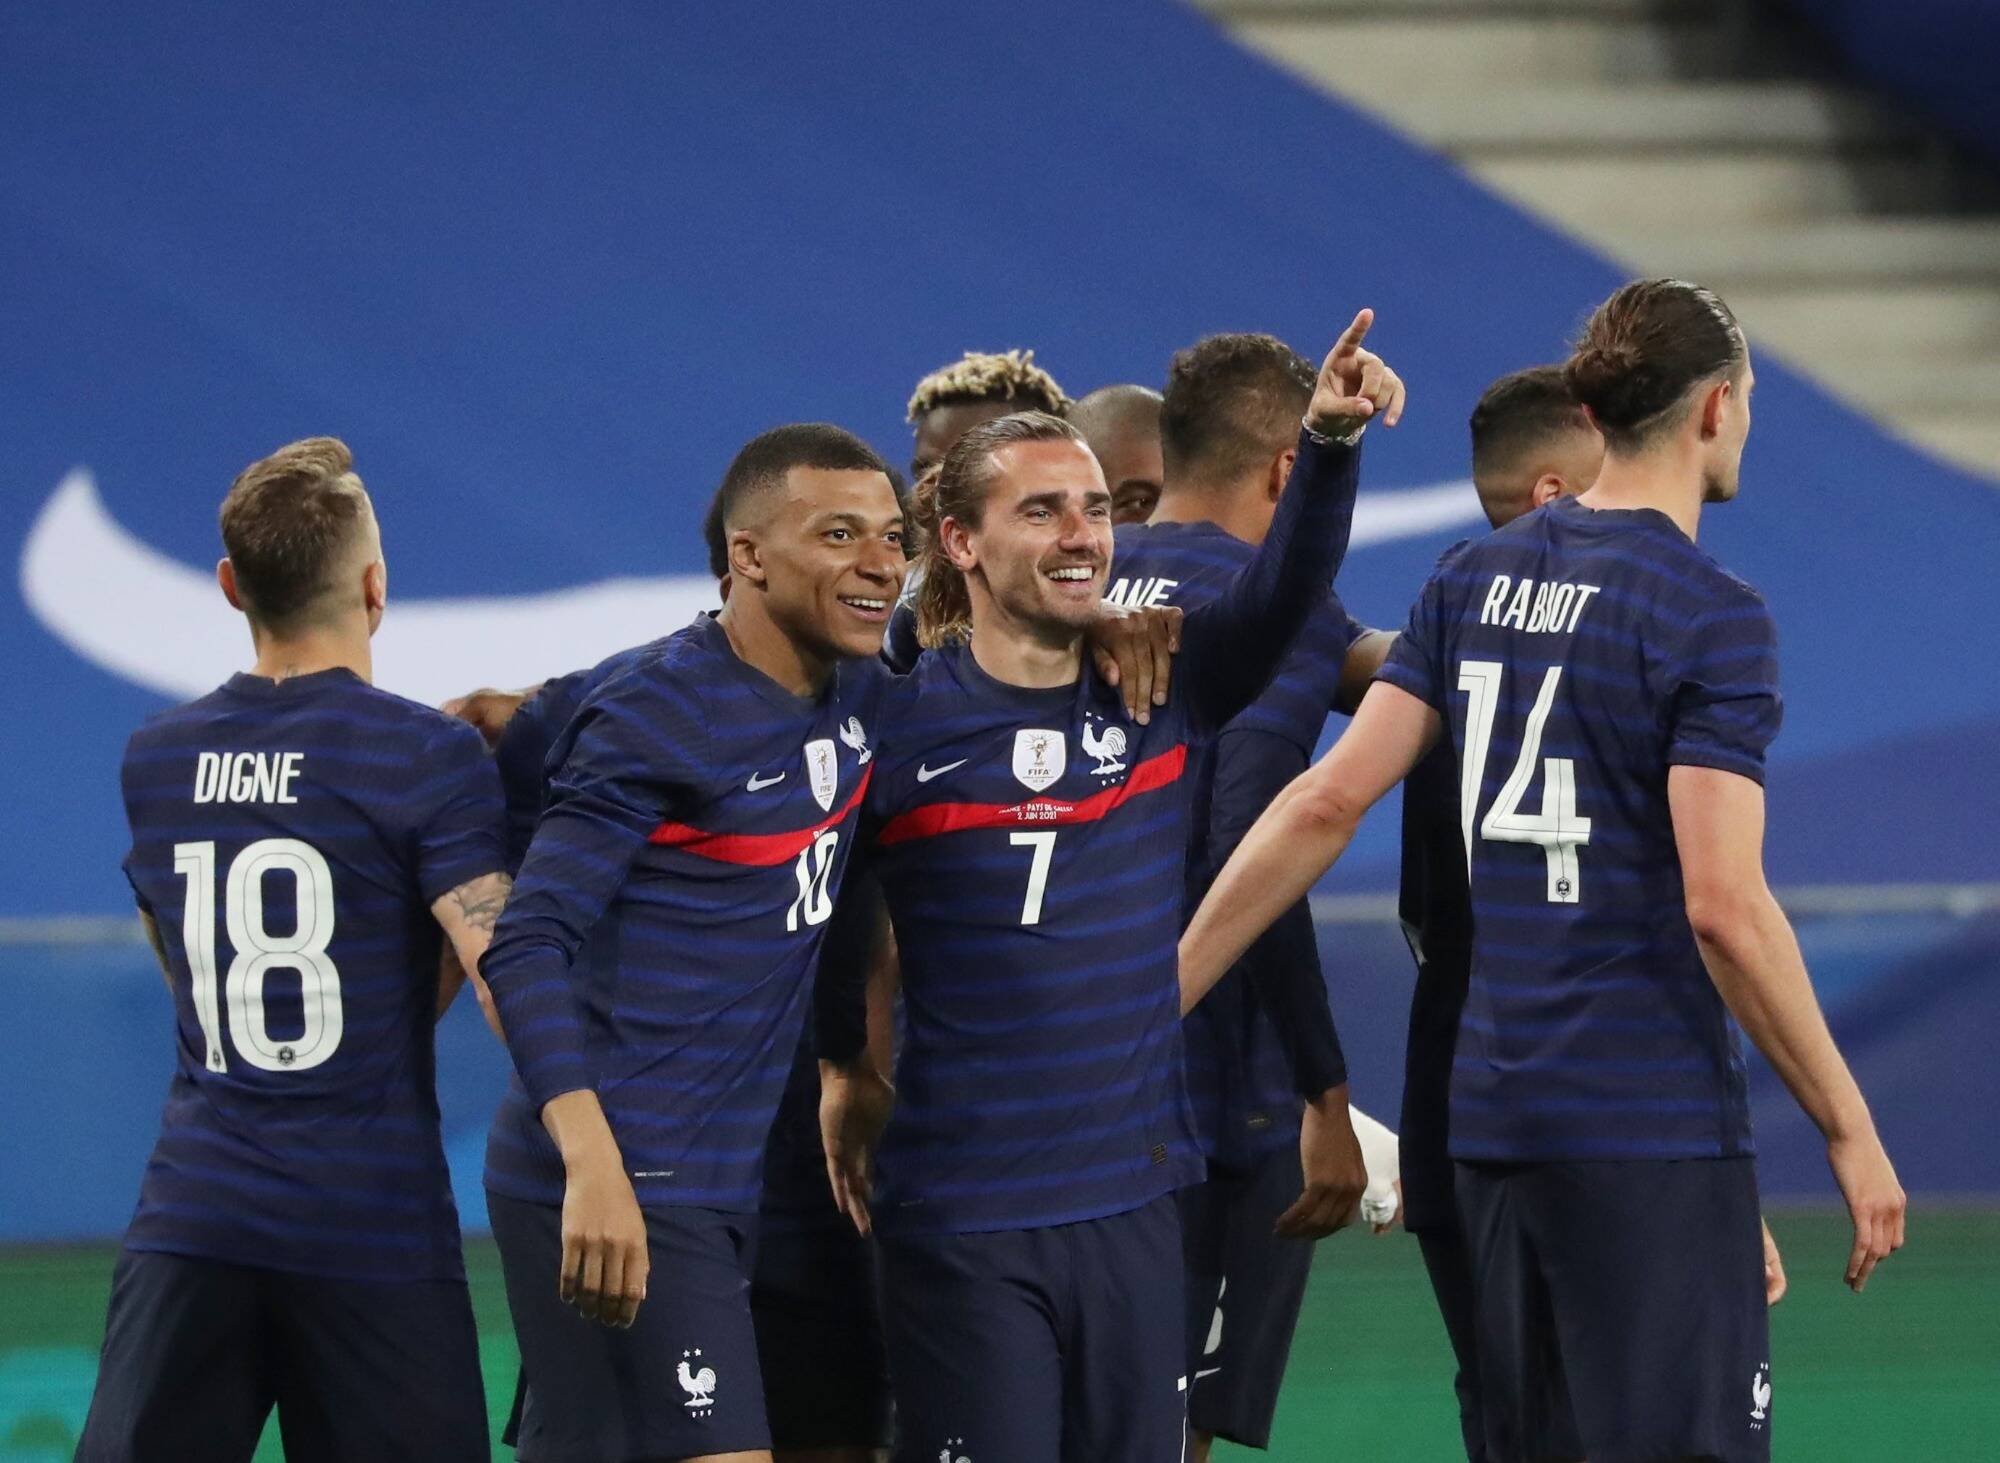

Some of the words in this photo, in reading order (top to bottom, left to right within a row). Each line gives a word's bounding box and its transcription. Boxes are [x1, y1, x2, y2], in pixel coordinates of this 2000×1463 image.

[1480, 575, 1600, 634] RABIOT
[193, 752, 305, 803] DIGNE
[1040, 811, 1056, 819] 2021
[1457, 661, 1592, 904] 14
[786, 830, 838, 932] 10
[1010, 832, 1058, 924] 7
[174, 838, 343, 1073] 18
